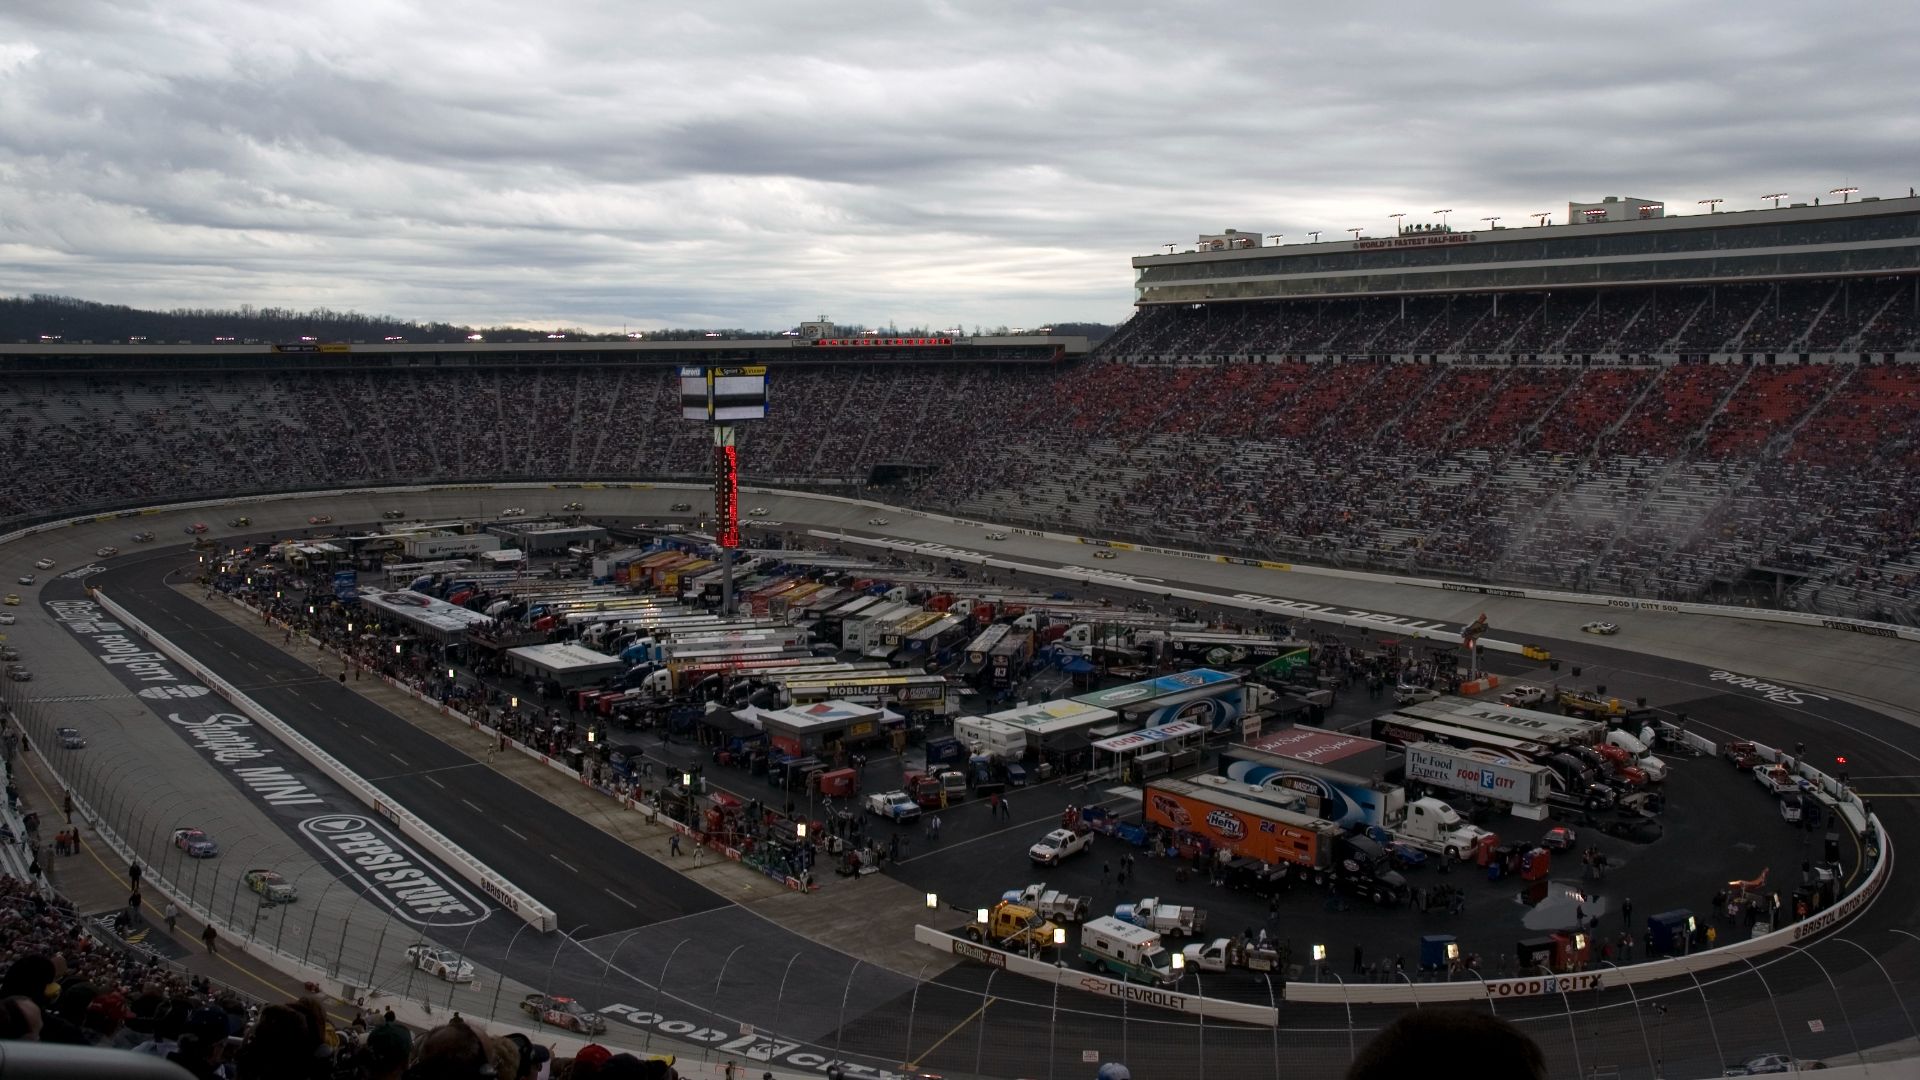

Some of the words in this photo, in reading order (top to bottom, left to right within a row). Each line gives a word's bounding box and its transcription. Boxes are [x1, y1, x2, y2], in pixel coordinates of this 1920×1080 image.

[1360, 240, 1392, 249] WORLD'S
[1395, 237, 1427, 246] FASTEST
[1428, 235, 1468, 244] HALF-MILE
[1608, 600, 1630, 608] FOOD
[1641, 602, 1659, 610] CITY
[885, 635, 899, 645] CAT
[1855, 625, 1898, 638] TENNESSEE
[92, 634, 141, 653] FOOD
[126, 661, 179, 681] CITY
[829, 685, 890, 696] MOBIL-IZE!
[1710, 670, 1829, 705] Sharpie
[1472, 711, 1548, 729] NAVY
[168, 712, 275, 763] Sharpie
[1107, 735, 1145, 749] FOOD
[1160, 723, 1192, 735] CITY
[1411, 752, 1428, 766] The
[1430, 756, 1453, 770] Food
[1411, 764, 1449, 780] Experts
[233, 766, 325, 806] MINI
[1457, 768, 1480, 782] FOOD
[1495, 777, 1516, 789] CITY
[1211, 816, 1238, 832] Hefty
[1259, 820, 1276, 833] 24
[329, 831, 411, 871] PEPSI
[375, 867, 471, 915] STUFF
[486, 880, 513, 909] BRISTOL
[1802, 912, 1835, 936] BRISTOL
[1839, 896, 1861, 916] MOTOR
[1109, 983, 1187, 1010] CHEVROLET
[1486, 981, 1541, 997] FOOD
[1559, 974, 1602, 990] CITY
[600, 1003, 728, 1042] FOOD
